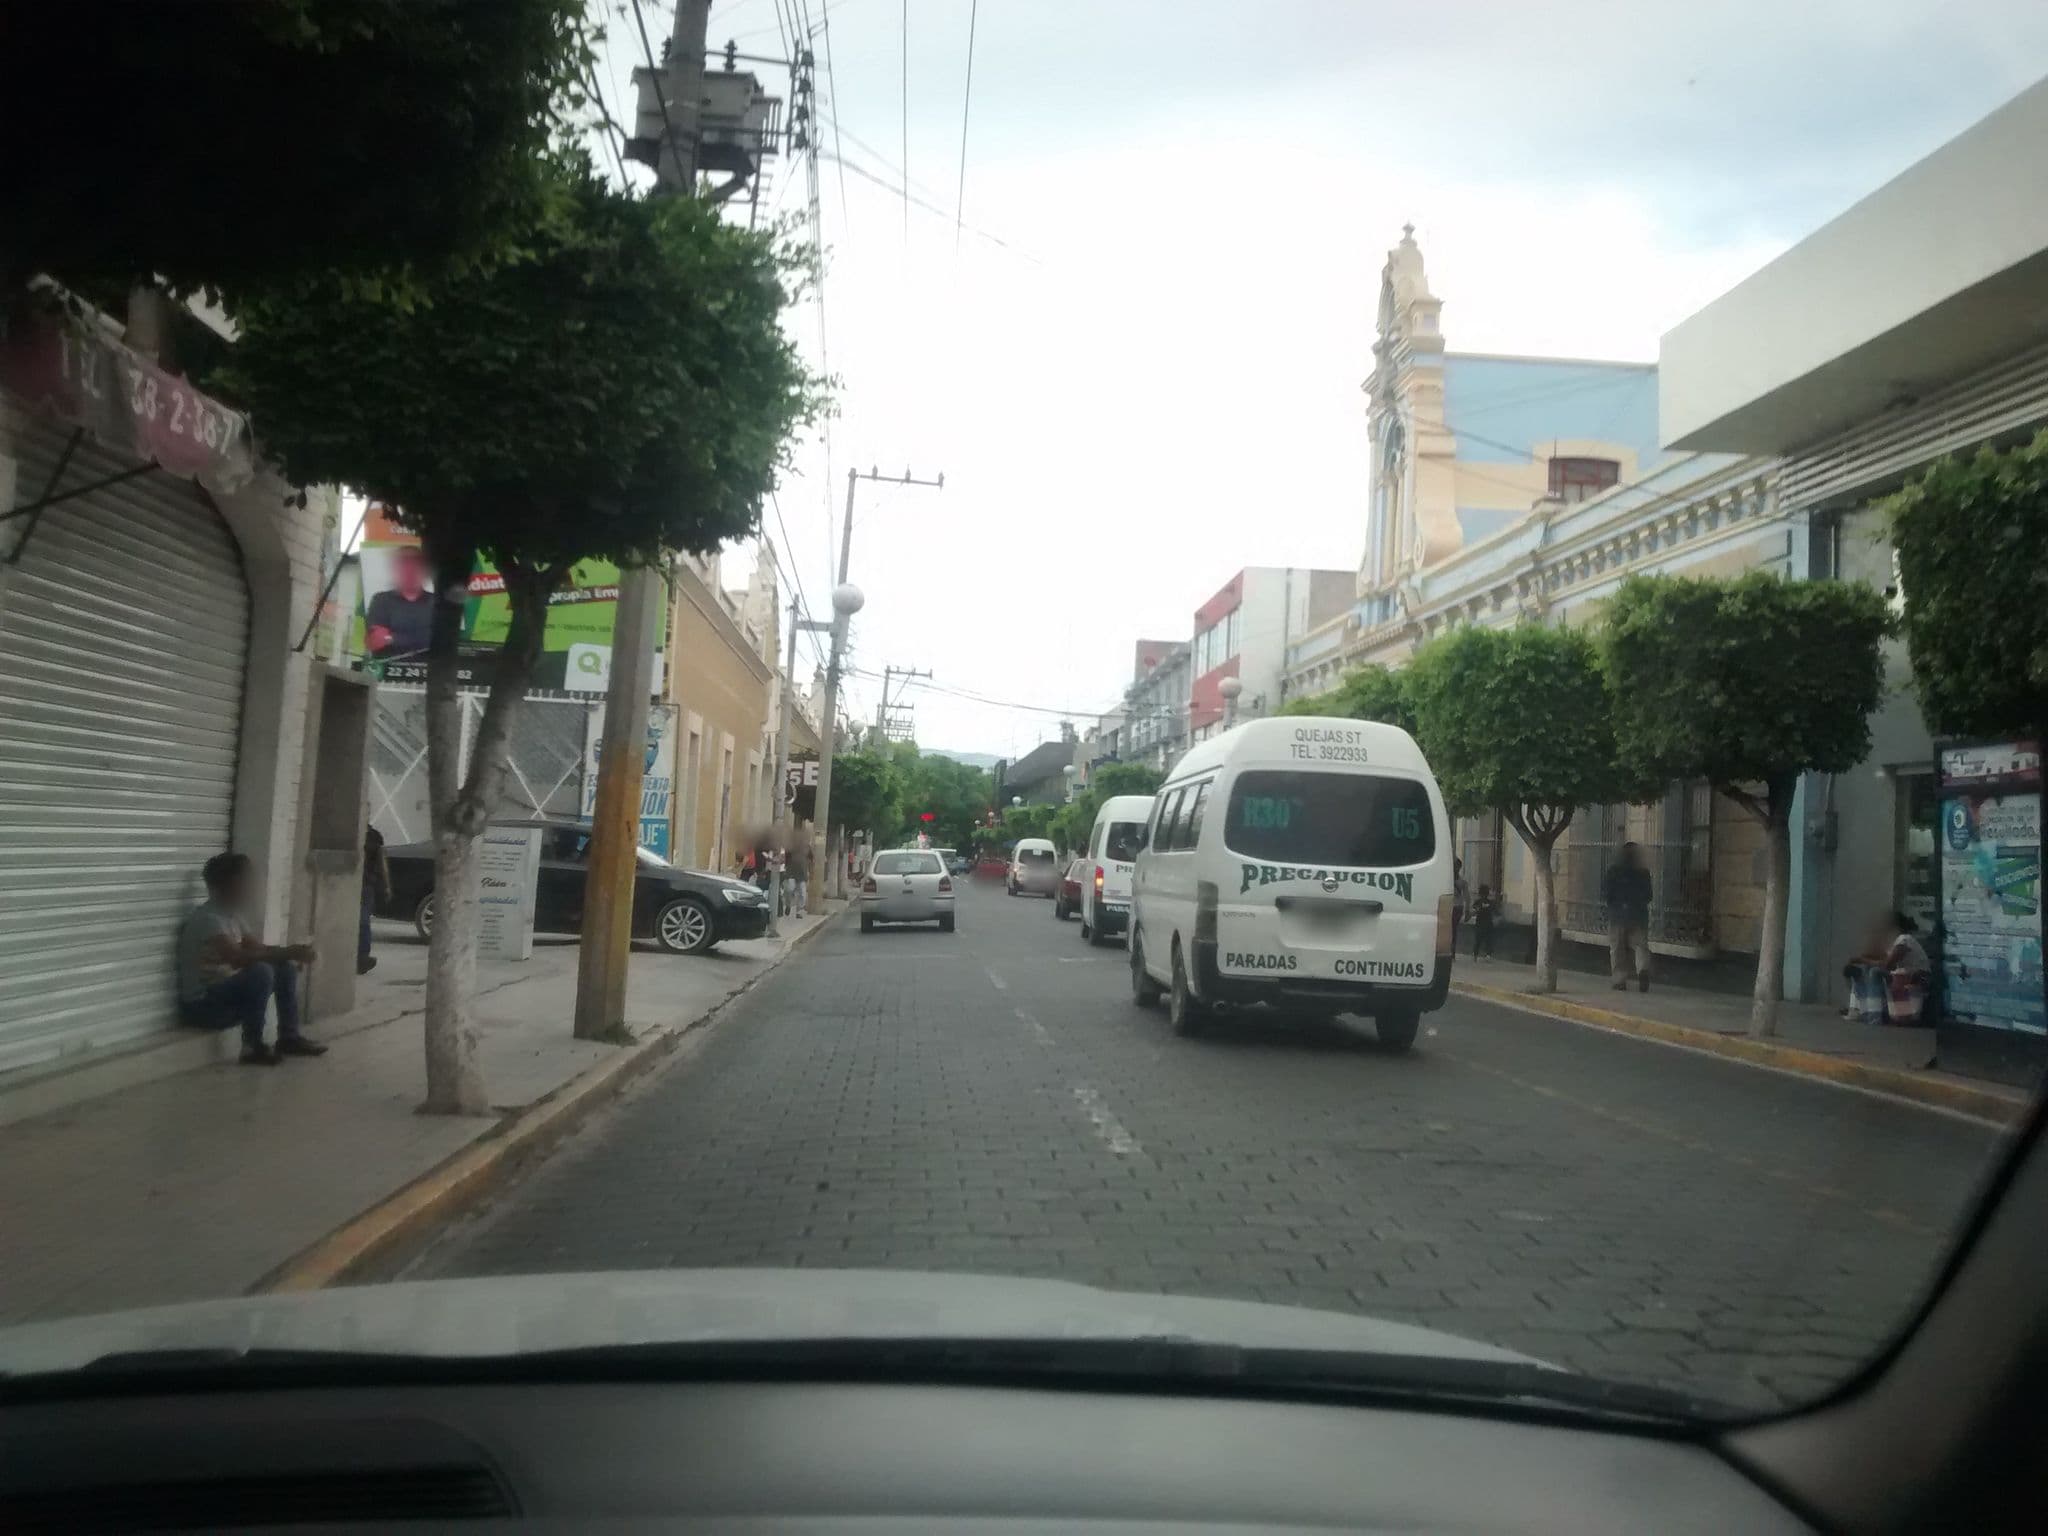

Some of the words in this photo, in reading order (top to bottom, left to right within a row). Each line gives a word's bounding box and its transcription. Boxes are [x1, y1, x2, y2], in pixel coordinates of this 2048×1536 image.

[1295, 727, 1345, 744] QUEJAS
[1319, 745, 1368, 762] 3922933
[640, 791, 668, 816] ION
[1239, 863, 1415, 905] PRECAUCION
[1226, 952, 1298, 970] PARADAS
[1334, 959, 1425, 978] CONTINUAS
